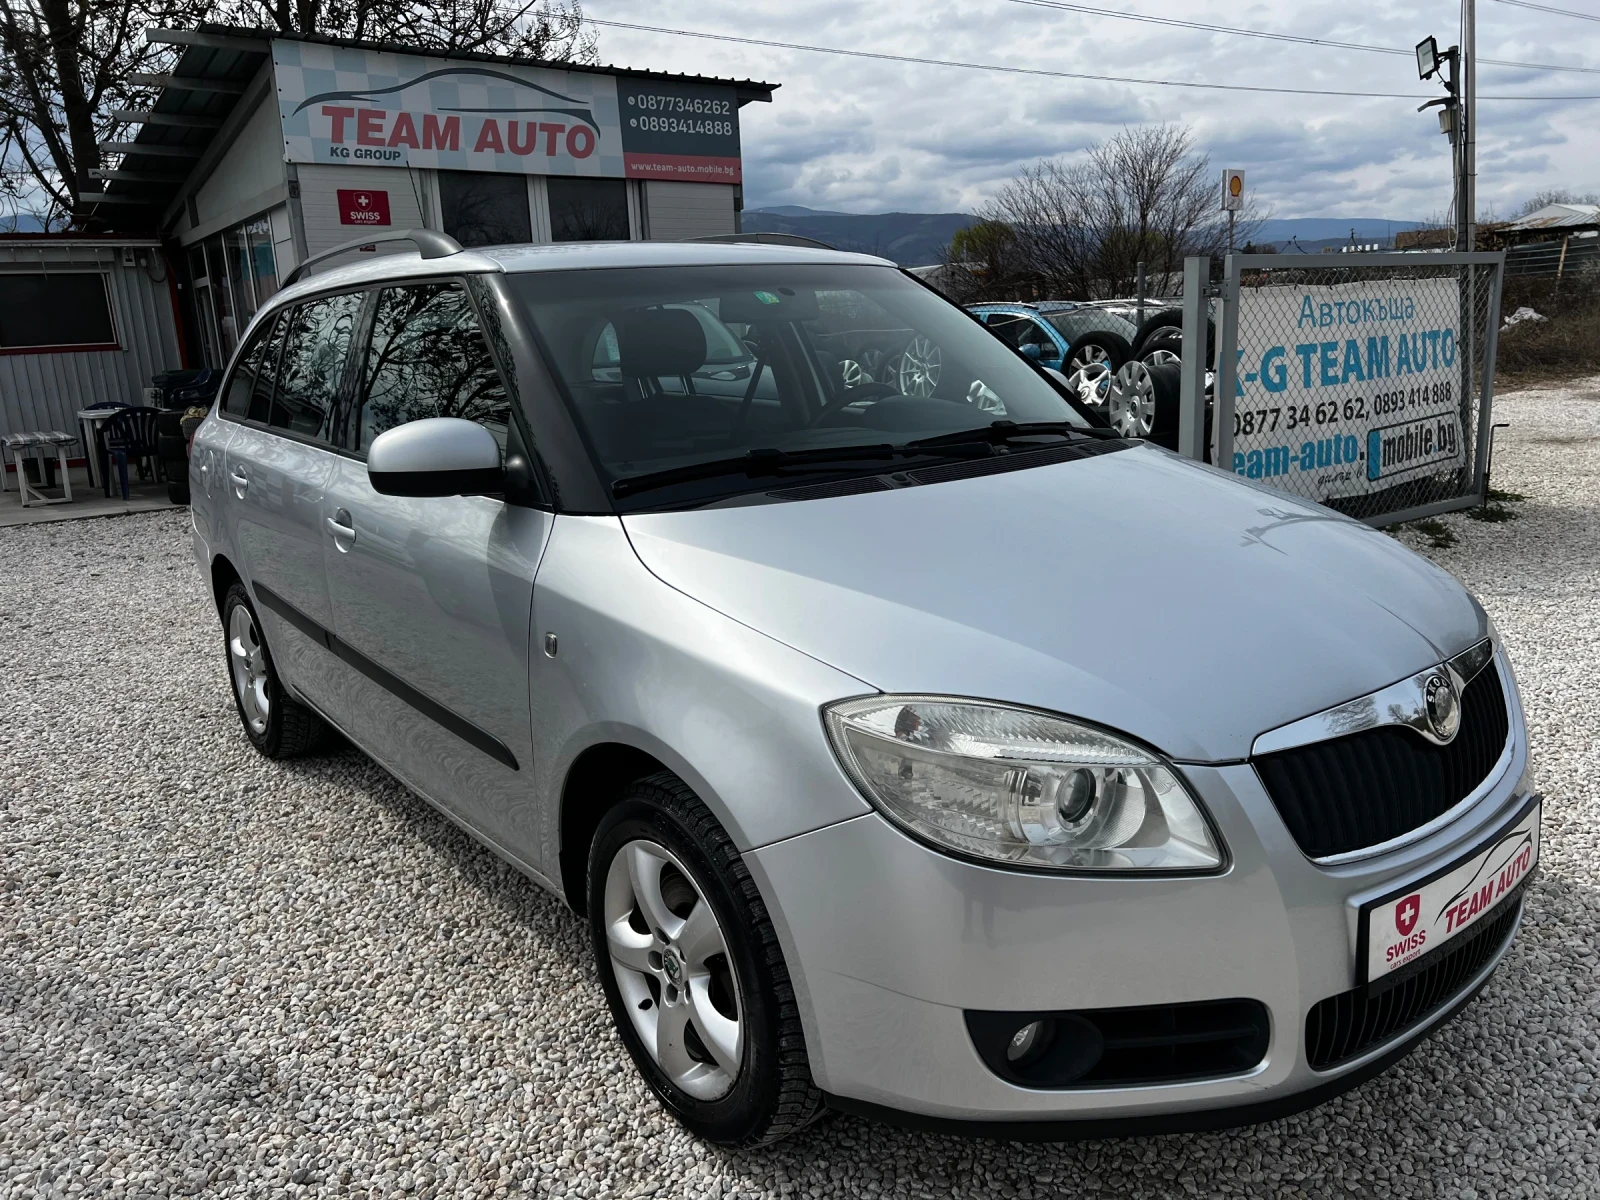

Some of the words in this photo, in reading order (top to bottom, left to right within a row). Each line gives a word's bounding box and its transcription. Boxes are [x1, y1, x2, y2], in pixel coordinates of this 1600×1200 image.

[637, 94, 731, 115] 0877346262
[321, 105, 461, 152] TEAM
[473, 118, 596, 159] AUTO
[639, 116, 732, 136] 0893414888
[330, 146, 350, 158] KG
[354, 149, 402, 161] GROUP
[630, 162, 735, 176] www.team-auto.mobile.bg
[350, 211, 381, 220] SWISS
[1297, 294, 1415, 328] Автокъща
[1296, 335, 1391, 389] TEAM
[1396, 327, 1456, 376] AUTO
[1286, 405, 1310, 430] 34
[1315, 400, 1339, 425] 62
[1343, 397, 1370, 421] 62,
[1374, 390, 1406, 416] 0893
[1408, 385, 1430, 409] 414
[1432, 381, 1452, 404] 888
[1233, 433, 1365, 479] eam-auto.
[1382, 420, 1456, 468] mobile.bg
[1445, 880, 1494, 934] TEAM
[1495, 846, 1531, 898] AUTO
[1385, 929, 1427, 962] SWISS
[1390, 959, 1402, 970] cars
[1402, 949, 1421, 963] export
